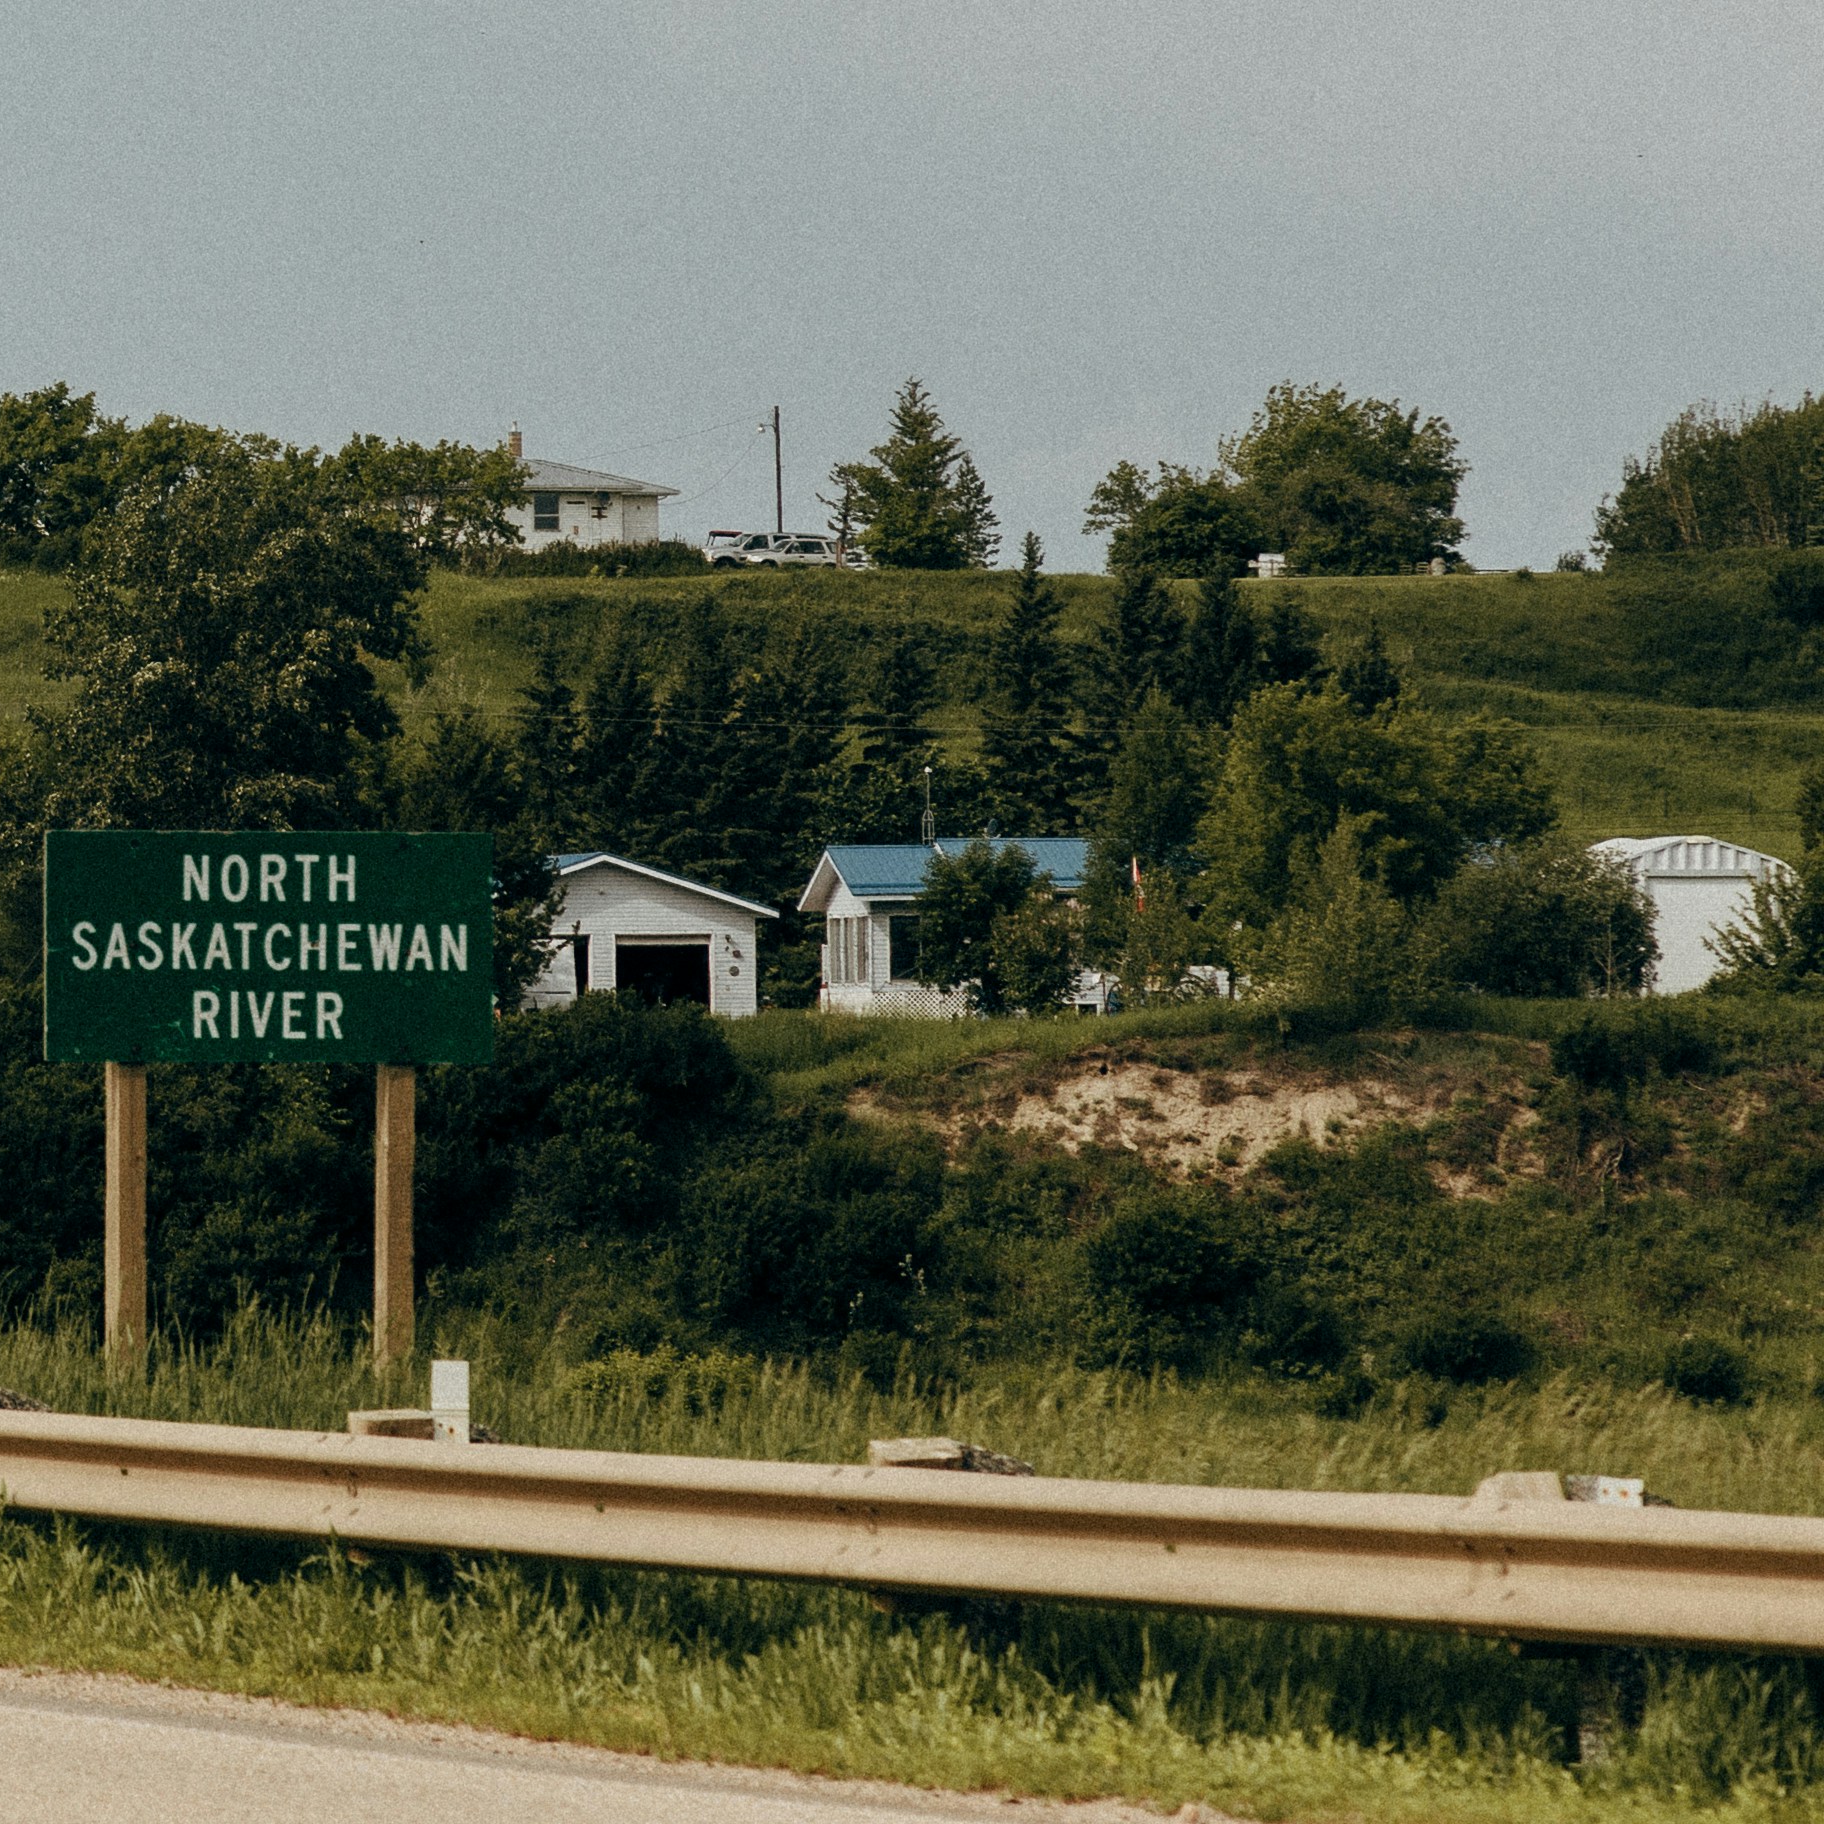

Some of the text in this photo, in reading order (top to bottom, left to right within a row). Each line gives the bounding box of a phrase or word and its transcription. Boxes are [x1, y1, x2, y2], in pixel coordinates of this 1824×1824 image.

[183, 854, 356, 902] NORTH
[72, 921, 467, 972] SASKATCHEWAN
[193, 991, 344, 1040] RIVER
